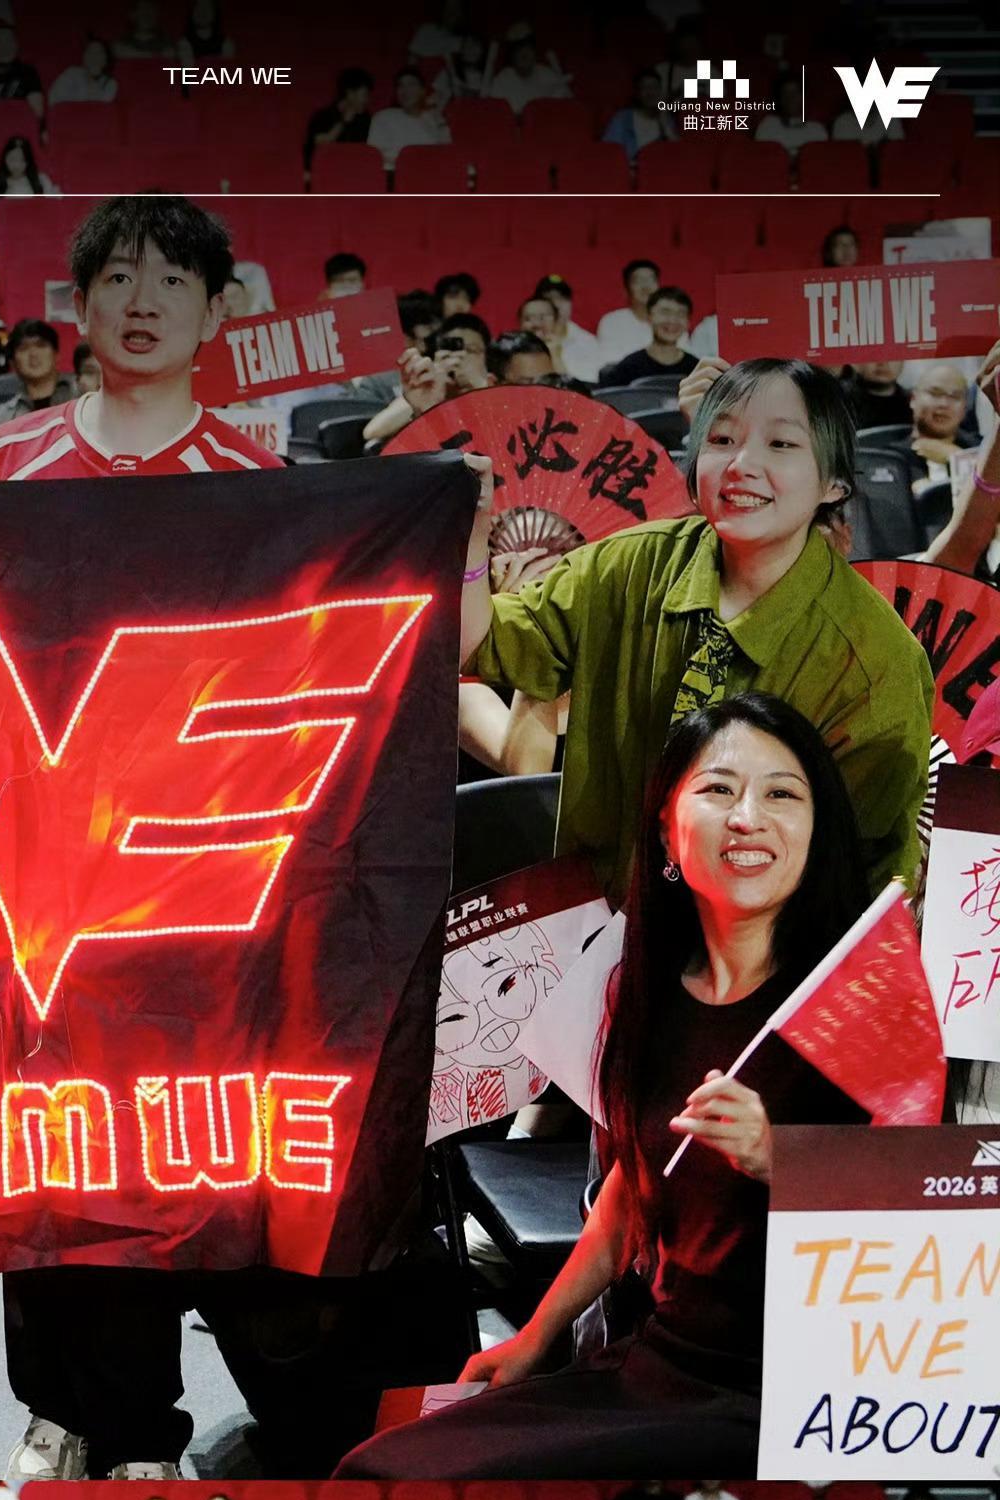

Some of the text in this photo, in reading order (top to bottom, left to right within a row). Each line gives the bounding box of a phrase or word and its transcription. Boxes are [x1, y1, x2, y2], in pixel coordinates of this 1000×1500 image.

[804, 275, 937, 348] TEAM WE
[225, 310, 344, 387] TEAM WE
[444, 903, 530, 946] 雄联盟职业联赛
[446, 894, 495, 928] LPL
[136, 1071, 353, 1195] WE
[922, 1175, 977, 1197] 2026
[849, 1318, 970, 1379] WE
